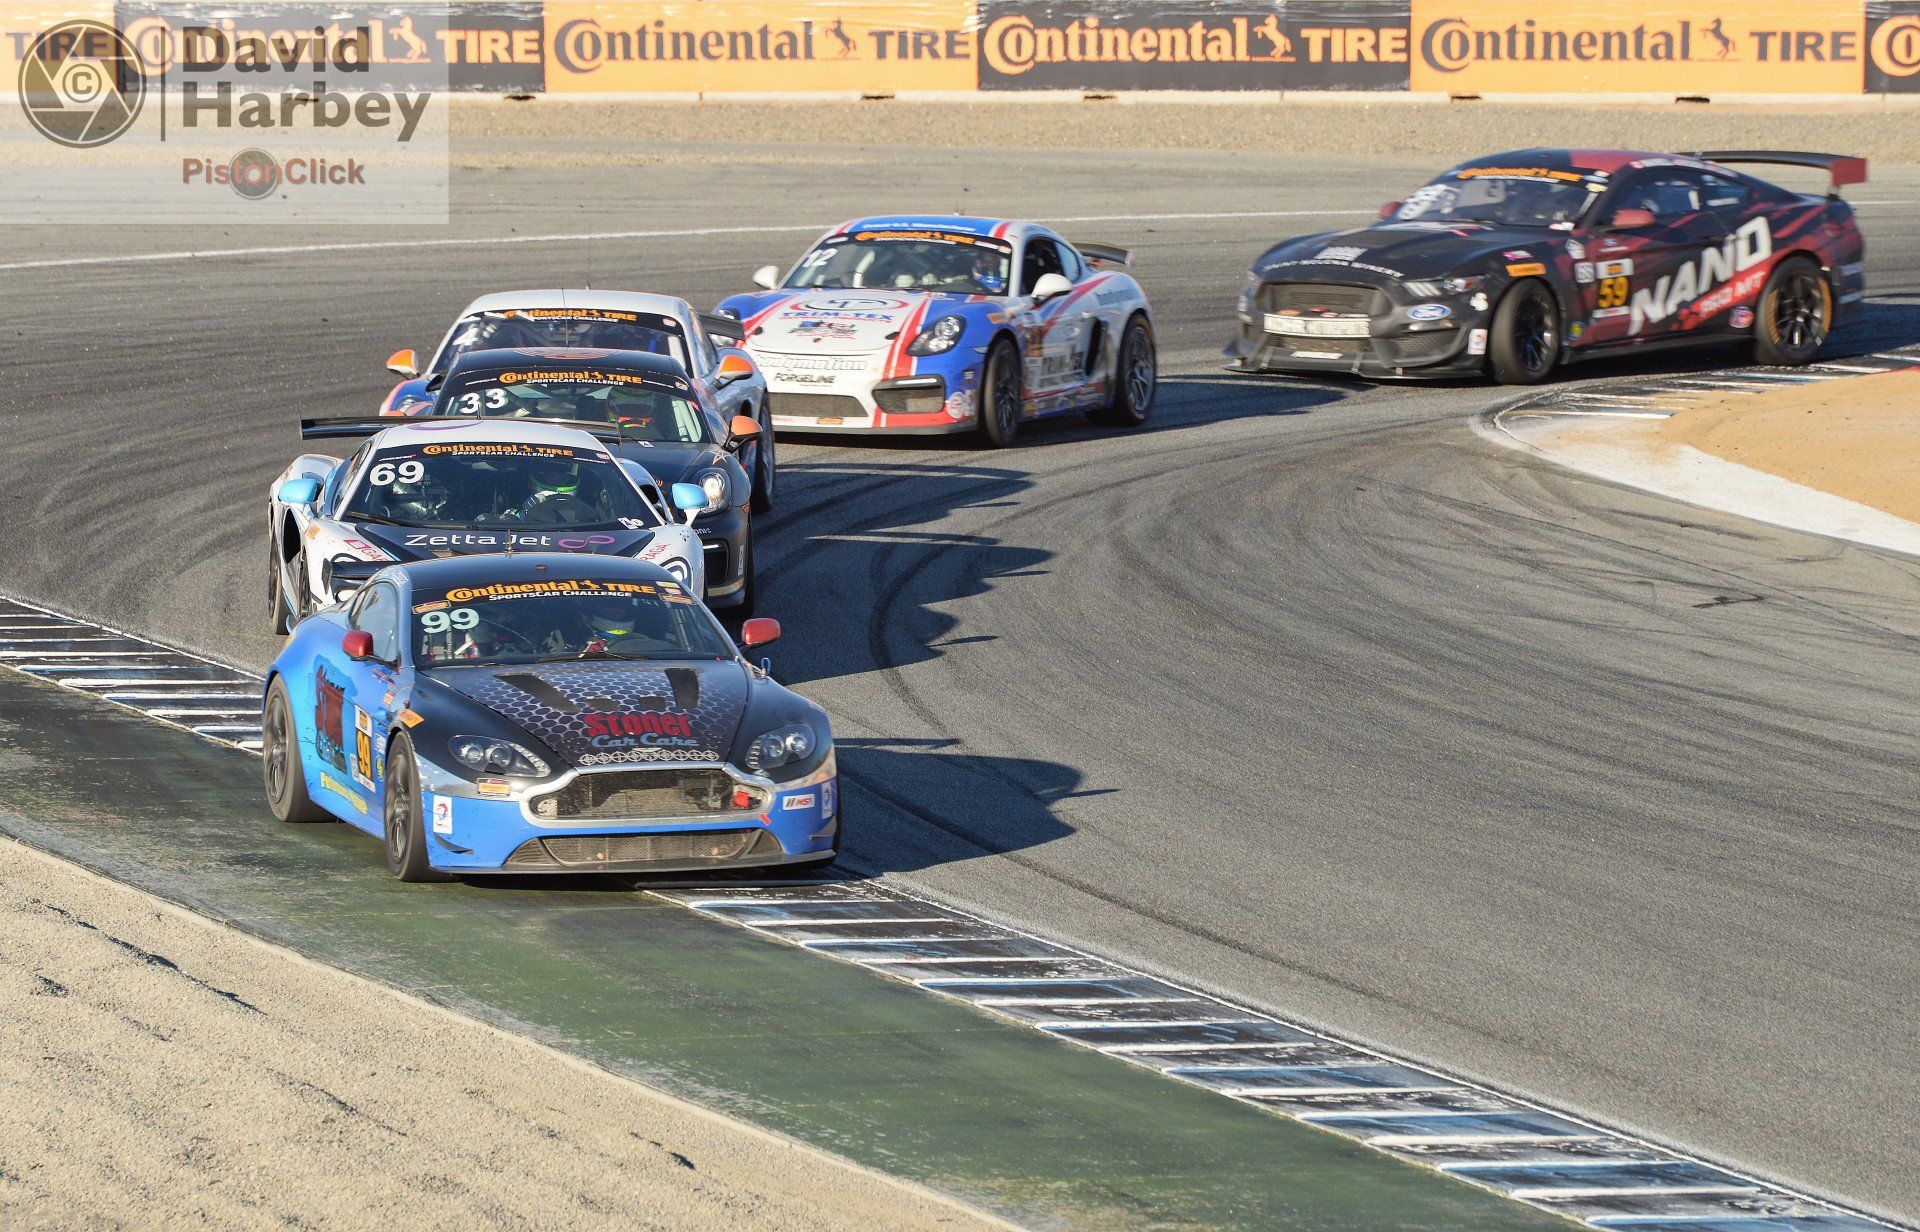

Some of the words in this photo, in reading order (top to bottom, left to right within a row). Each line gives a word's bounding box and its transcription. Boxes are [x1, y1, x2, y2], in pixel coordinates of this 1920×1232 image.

[6, 32, 110, 61] TIRE
[121, 16, 389, 76] Continental
[437, 29, 541, 64] TIRE
[554, 19, 816, 74] Continental
[868, 30, 970, 60] TIRE
[983, 15, 1253, 75] Continental
[1300, 28, 1408, 63] TIRE
[1420, 16, 1692, 73] Continental
[1750, 31, 1857, 62] TIRE
[803, 248, 838, 268] 12
[1627, 216, 1772, 336] NAND
[1598, 276, 1629, 309] 59
[499, 371, 589, 384] Continental
[606, 373, 643, 384] TIRE
[459, 388, 506, 414] 33
[422, 444, 516, 455] Continental
[536, 447, 574, 457] TIRE
[369, 460, 425, 486] 69
[404, 534, 497, 546] Zetta
[503, 534, 551, 546] Jet
[445, 580, 579, 602] Continental
[602, 583, 657, 594] TIRE
[489, 590, 560, 601] SPORTSCAR
[420, 608, 480, 634] 99
[583, 713, 692, 737] Stoner
[591, 734, 640, 748] Car
[639, 733, 701, 747] Care
[357, 730, 372, 780] 99
